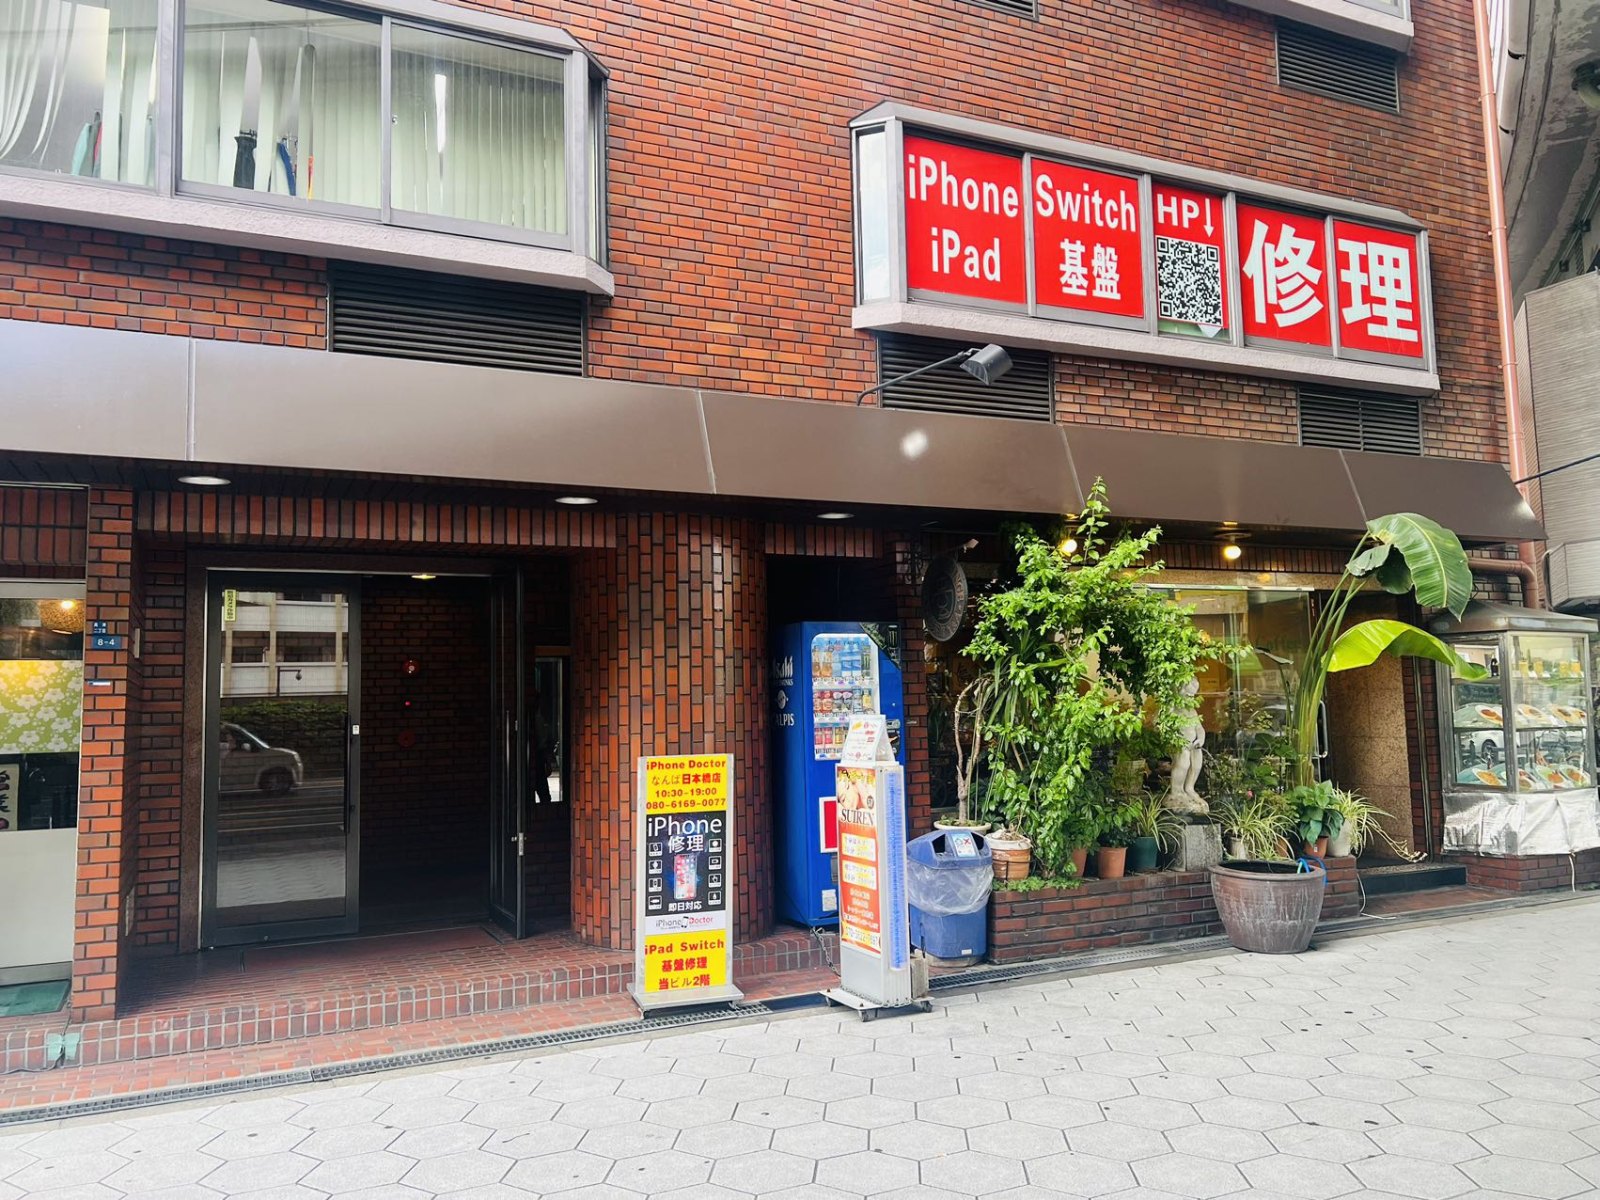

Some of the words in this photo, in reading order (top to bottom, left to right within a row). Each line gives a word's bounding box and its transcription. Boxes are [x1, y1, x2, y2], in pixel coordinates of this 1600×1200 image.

[909, 154, 1019, 219] iPhone
[1036, 174, 1137, 233] Switch
[1157, 193, 1200, 230] HP
[931, 229, 1001, 282] iPad
[1060, 239, 1121, 301] 基盤
[1243, 219, 1419, 344] 修理
[97, 638, 116, 646] 8-4
[774, 713, 795, 727] ALPIS
[646, 761, 685, 770] iPhone
[688, 760, 726, 768] Doctor
[652, 773, 721, 786] なんば日本橋店
[655, 787, 717, 798] 10:30-19:00
[646, 798, 726, 809] 080-6169-0077
[648, 816, 722, 836] iPhone
[668, 834, 704, 853] 修理
[668, 901, 702, 911] 即日対応
[656, 919, 681, 927] iPhone
[688, 916, 713, 924] Doctor
[644, 943, 673, 955] iPad
[680, 939, 724, 952] Switch
[662, 957, 708, 972] 基盤修理
[659, 974, 710, 990] 当ビル2階
